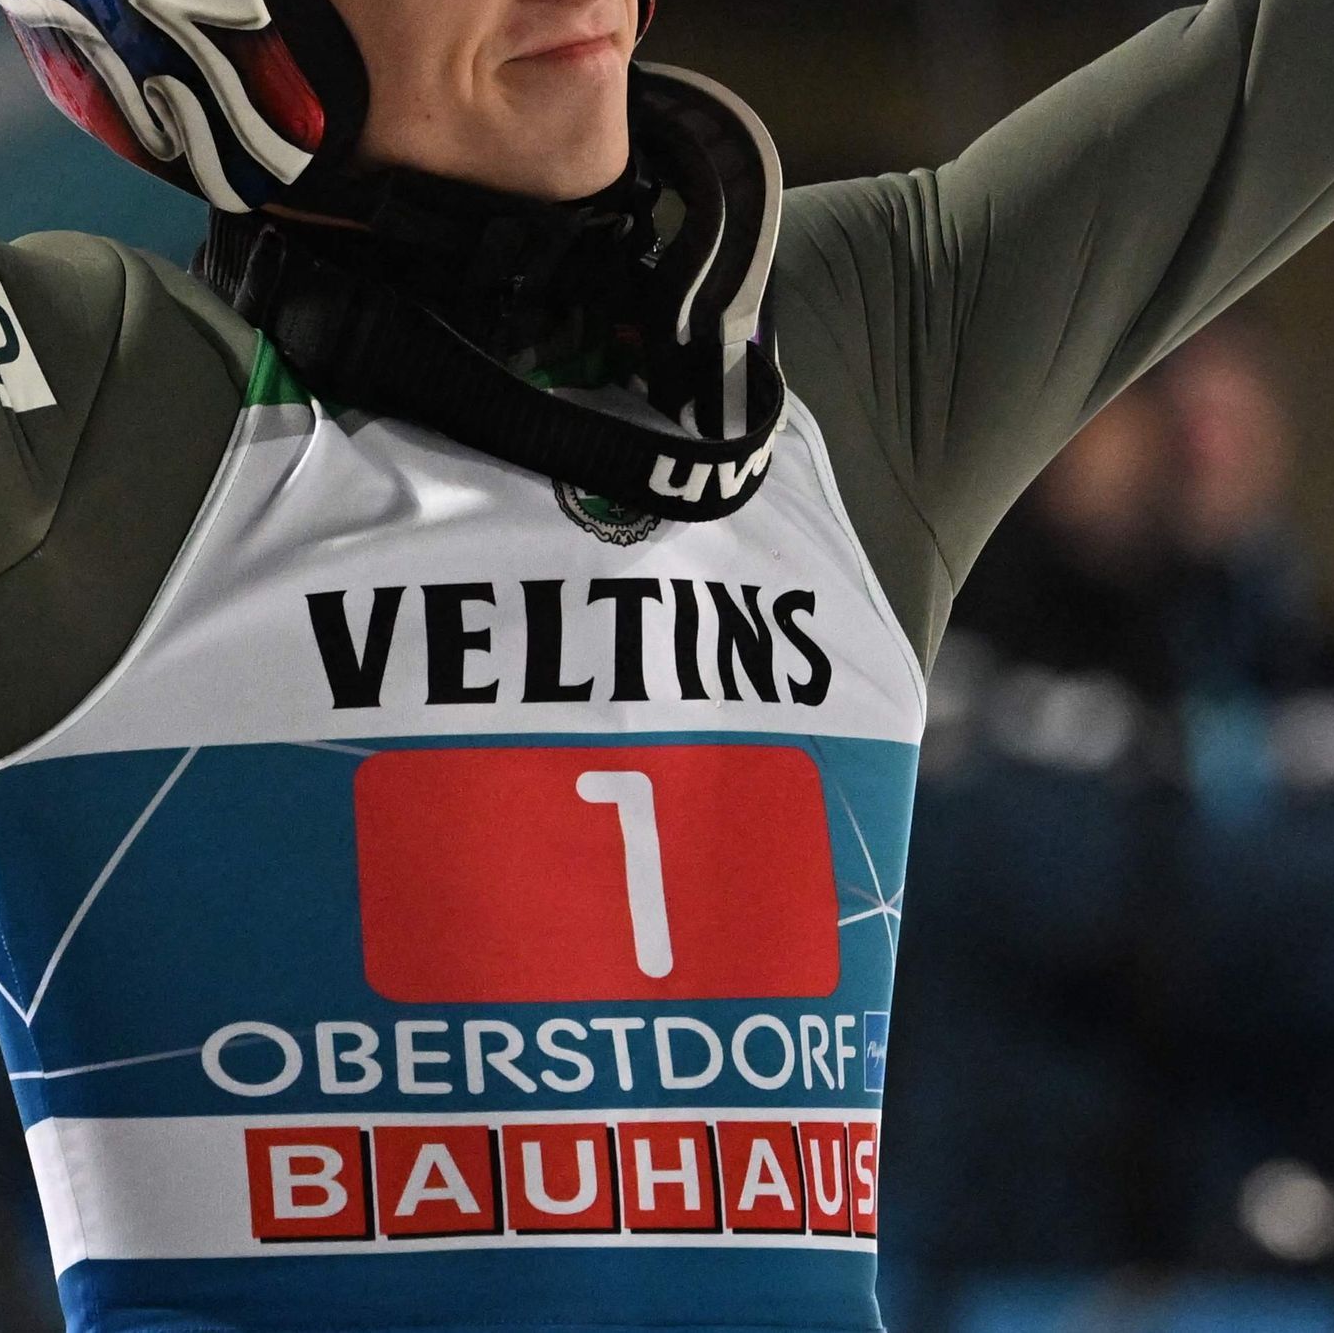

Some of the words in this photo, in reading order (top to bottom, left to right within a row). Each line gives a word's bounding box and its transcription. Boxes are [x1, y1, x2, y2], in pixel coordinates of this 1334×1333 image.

[648, 428, 776, 503] uv
[305, 577, 833, 711] VELTINS
[576, 770, 674, 979] 1
[200, 1012, 857, 1096] OBERSTDORF
[267, 1138, 875, 1222] BAUHAUS
